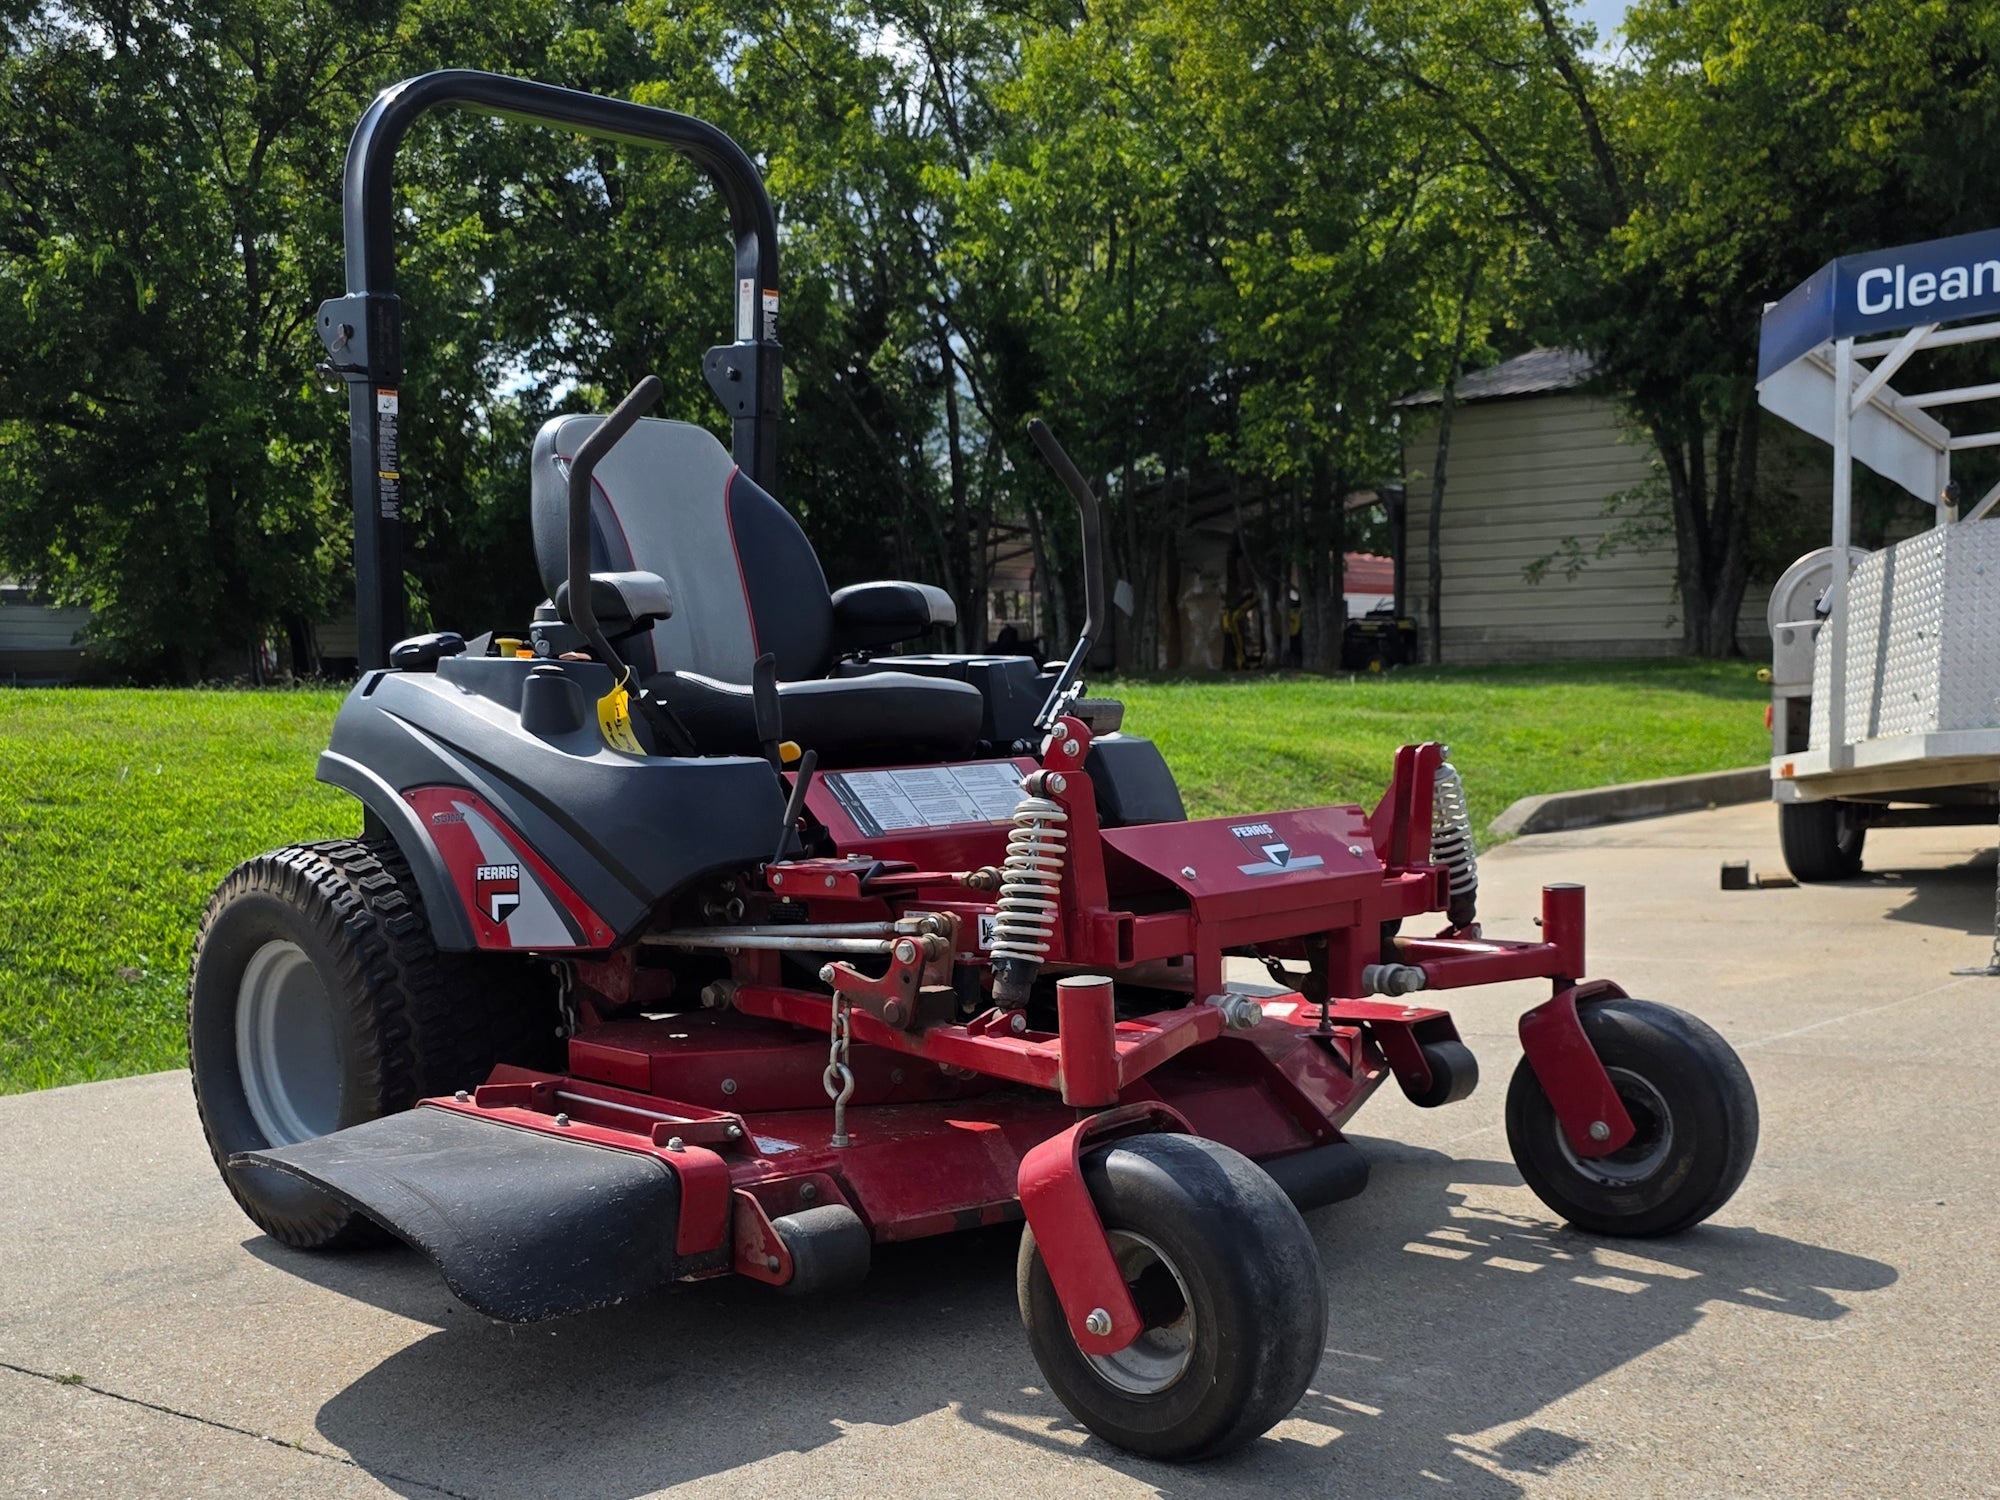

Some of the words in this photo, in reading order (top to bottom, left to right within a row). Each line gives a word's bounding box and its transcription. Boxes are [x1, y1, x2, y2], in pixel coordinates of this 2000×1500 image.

[1856, 259, 2000, 315] Clean
[1231, 823, 1274, 838] FERRIS
[476, 865, 519, 880] FERRIS
